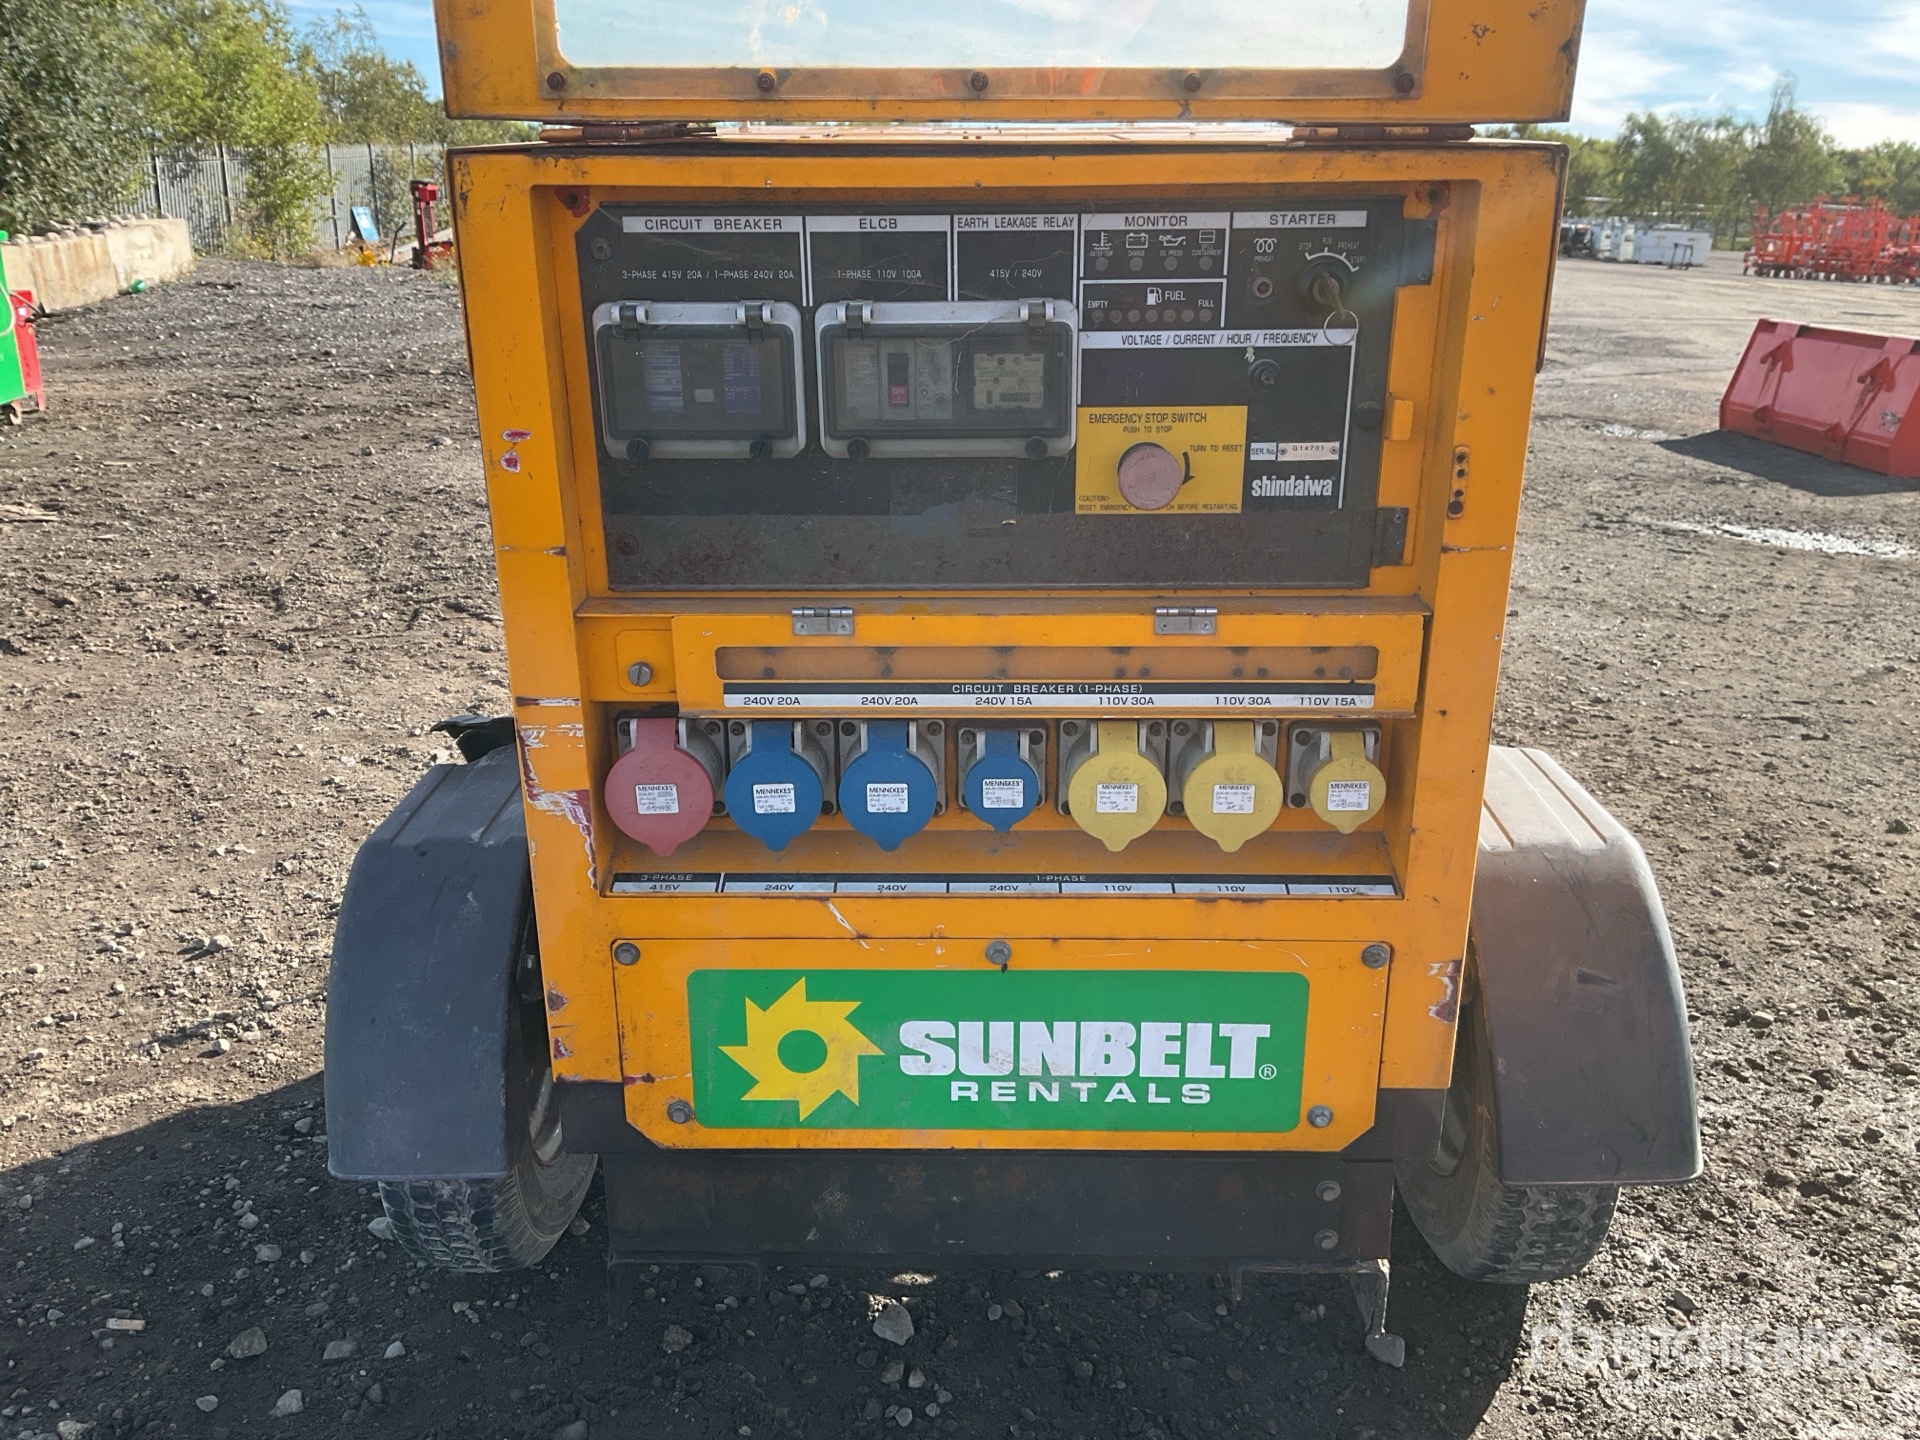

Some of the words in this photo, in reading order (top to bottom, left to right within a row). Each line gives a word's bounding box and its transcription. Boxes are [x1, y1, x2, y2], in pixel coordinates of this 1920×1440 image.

[645, 219, 702, 230] CIRCUIT
[714, 219, 782, 230] BREAKER
[859, 218, 898, 230] ELCB
[957, 217, 989, 229] EARTH
[995, 216, 1037, 229] LEAKAGE
[1043, 216, 1075, 228] RELAY
[1124, 215, 1188, 227] MONITOR
[1269, 214, 1336, 225] STARTER
[1338, 242, 1360, 250] PREHEAT
[622, 270, 657, 279] 3-PHASE
[661, 270, 682, 279] 415V
[687, 270, 702, 279] 20A
[714, 270, 749, 279] 1-PHASE
[753, 270, 774, 279] 240V
[778, 270, 794, 279] 20A
[837, 270, 871, 279] 1-PHASE
[877, 270, 896, 279] 110V
[902, 270, 922, 279] 100A
[989, 269, 1011, 278] 415V
[1021, 269, 1042, 278] 240V
[1165, 290, 1186, 301] FUEL
[1088, 300, 1108, 309] EMPTY
[1198, 300, 1214, 308] FULL
[1121, 335, 1162, 346] VOLTAGE
[1173, 334, 1215, 345] CURRENT
[1227, 334, 1251, 345] HOUR
[1263, 333, 1318, 344] FREQUENCY
[1089, 413, 1142, 424] EMERGENCY
[1144, 413, 1169, 423] STOP
[1171, 413, 1207, 423] SWITCH
[1251, 475, 1333, 497] shindaiwa
[952, 684, 1004, 694] CIRCUIT
[1013, 684, 1074, 694] BREAKER
[1078, 684, 1143, 694] (1-PHASE)
[743, 696, 776, 706] 240V
[777, 696, 800, 706] 20A
[861, 696, 894, 706] 240V
[895, 696, 918, 706] 20A
[975, 696, 1006, 706] 240V
[1010, 696, 1032, 706] 15A
[1098, 696, 1128, 706] 110V
[1131, 696, 1155, 706] 30A
[1214, 696, 1245, 706] 110V
[1248, 696, 1272, 706] 30A
[1299, 696, 1330, 706] 110V
[1334, 696, 1356, 706] 15A
[640, 873, 693, 881] 3-PHASE
[1035, 874, 1087, 882] 1-PHASE
[649, 883, 680, 892] 415V
[764, 883, 795, 892] 240V
[877, 884, 907, 892] 240V
[989, 884, 1019, 892] 240V
[1104, 884, 1132, 892] 110V
[1217, 885, 1246, 893] 110V
[1328, 886, 1356, 894] 110V
[900, 1021, 1271, 1079] SUNBELT
[950, 1081, 1211, 1104] RENTALS
